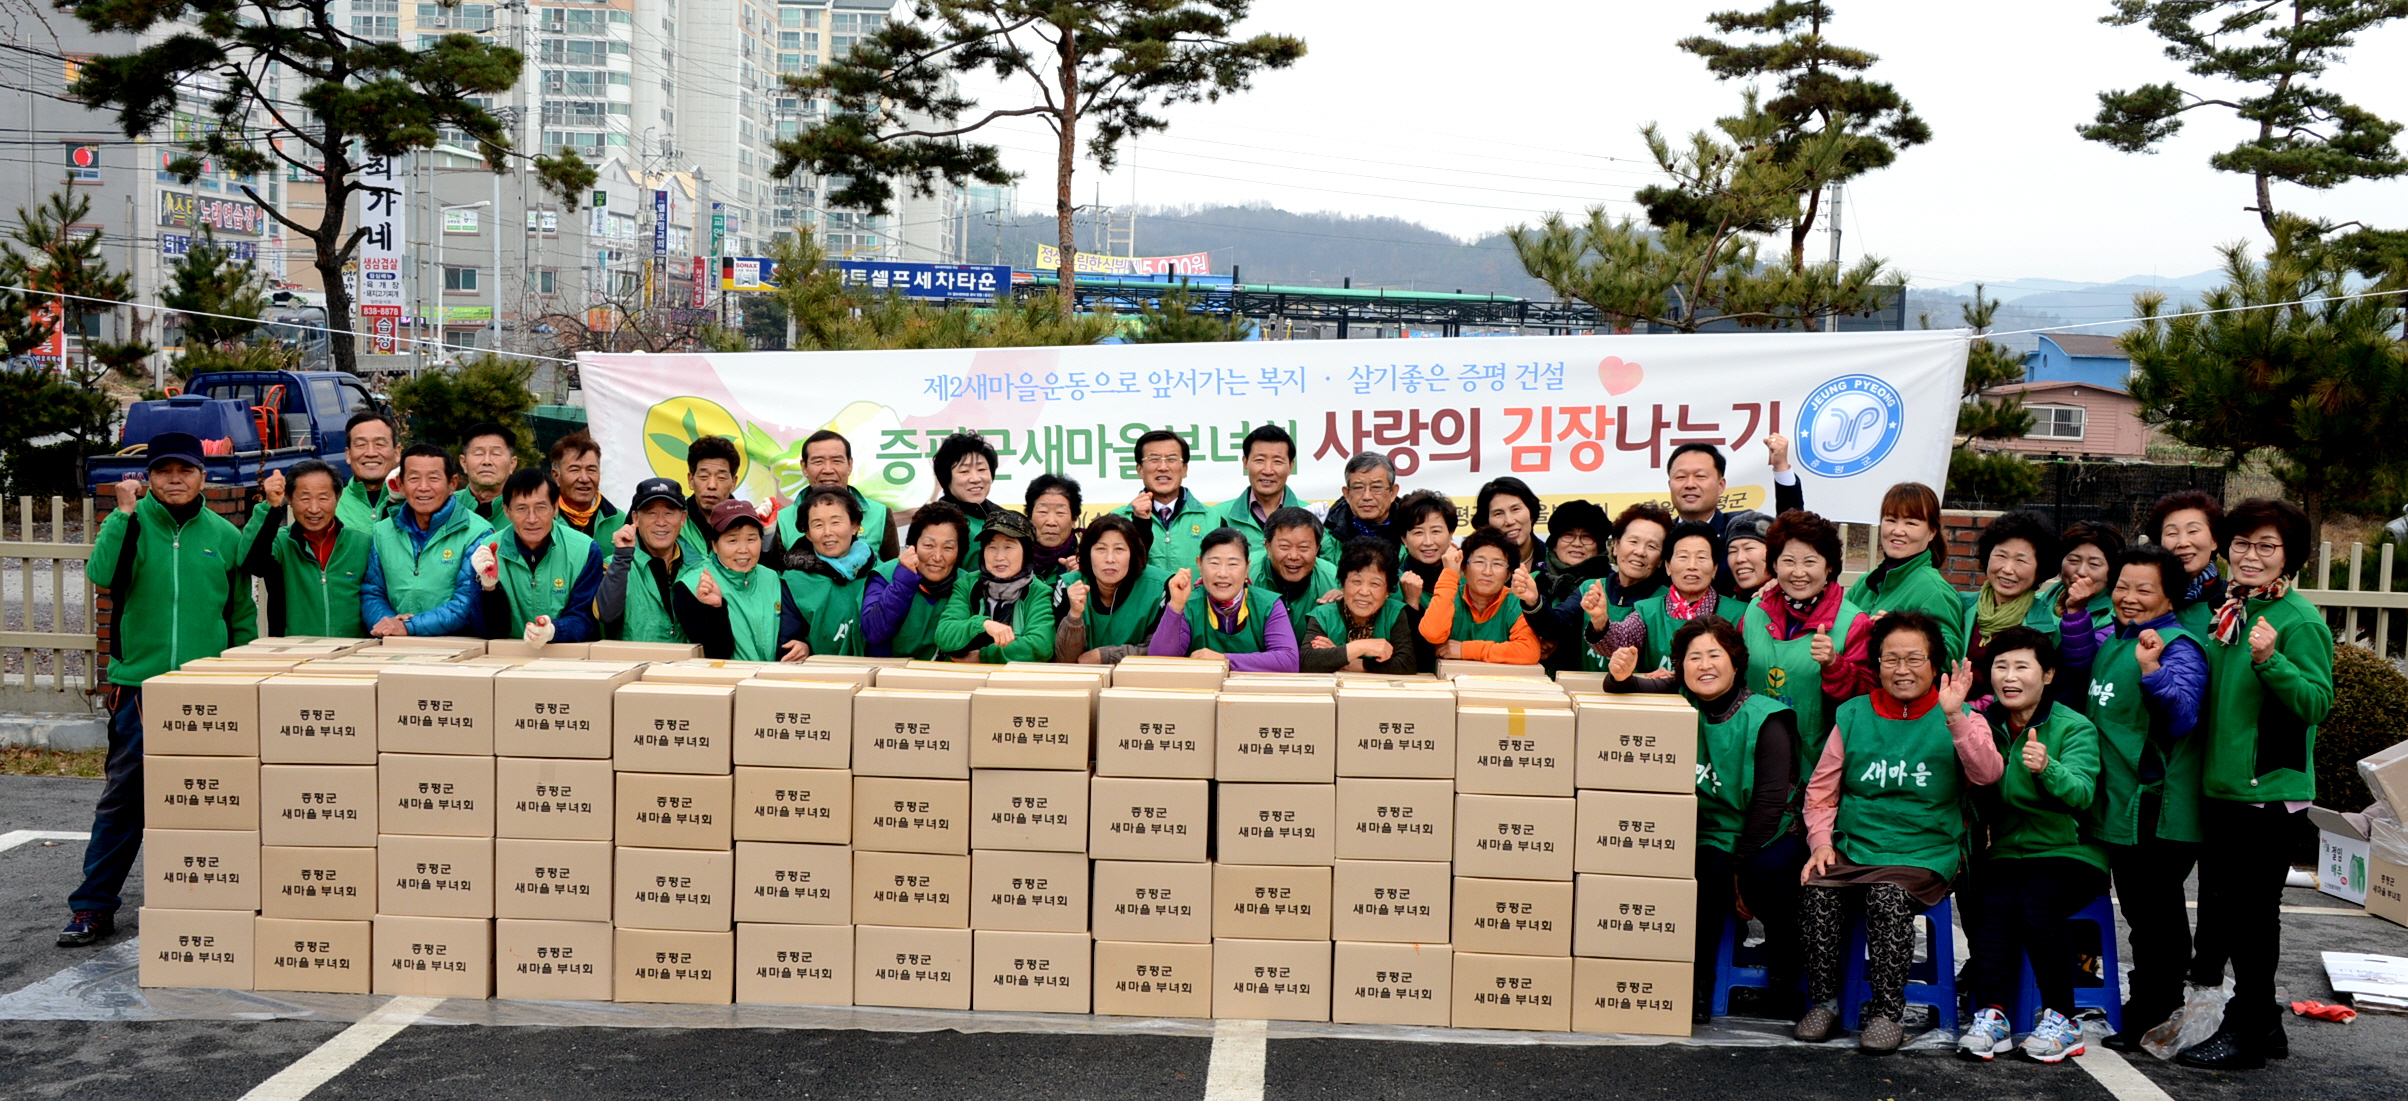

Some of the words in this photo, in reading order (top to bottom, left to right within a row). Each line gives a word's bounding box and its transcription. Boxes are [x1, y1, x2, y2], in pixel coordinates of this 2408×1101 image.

[200, 199, 255, 231] 노래연습장
[363, 257, 399, 270] 생삼겹살
[1142, 253, 1207, 275] 5000원
[363, 307, 399, 316] 838-8878
[923, 371, 1141, 402] 제2새마을운동으로
[1147, 367, 1251, 399] 앞서가는
[1256, 366, 1306, 396] 복지
[1347, 363, 1450, 395] 살기좋은
[1457, 362, 1507, 392] 증평
[1515, 361, 1566, 391] 건설
[1810, 381, 1848, 412] JEUNG
[1853, 379, 1897, 409] PYEONG
[1312, 407, 1481, 477] 사랑의
[1810, 455, 1873, 475] 증평군
[122, 471, 146, 482] KIA
[417, 699, 454, 712] 증평군
[299, 709, 336, 722] 증평군
[397, 714, 433, 727] 새마을
[437, 716, 473, 729] 부녀회
[774, 712, 811, 725] 증평군
[1012, 716, 1049, 729] 증평군
[279, 724, 316, 737] 새마을
[320, 725, 356, 737] 부녀회
[653, 718, 690, 731] 증평군
[1139, 722, 1176, 735] 증평군
[1378, 722, 1415, 735] 증평군
[633, 734, 669, 747] 새마을
[673, 735, 710, 748] 부녀회
[754, 727, 790, 740] 새마을
[794, 729, 831, 742] 부녀회
[991, 732, 1028, 745] 새마을
[1032, 733, 1069, 745] 부녀회
[1118, 738, 1155, 751] 새마을
[1159, 739, 1196, 752] 부녀회
[1357, 738, 1394, 751] 새마을
[1398, 739, 1435, 751] 부녀회
[1498, 739, 1535, 752] 증평군
[1476, 755, 1514, 768] 새마을
[1518, 756, 1555, 769] 부녀회
[1860, 759, 1933, 789] 새마을
[183, 778, 220, 791] 증평군
[418, 782, 454, 795] 증평군
[535, 785, 572, 798] 증평군
[163, 794, 200, 806] 새마을
[203, 794, 240, 807] 부녀회
[774, 789, 811, 802] 증평군
[398, 797, 434, 810] 새마을
[438, 799, 474, 811] 부녀회
[515, 800, 551, 813] 새마을
[555, 801, 592, 814] 부녀회
[893, 800, 930, 813] 증평군
[754, 805, 790, 818] 새마을
[794, 806, 831, 819] 부녀회
[1130, 806, 1168, 819] 증평군
[1258, 810, 1296, 823] 증평군
[873, 816, 909, 829] 새마을
[913, 817, 949, 830] 부녀회
[1109, 822, 1146, 835] 새마을
[1150, 823, 1187, 836] 부녀회
[1497, 822, 1535, 836] 증평군
[1618, 819, 1656, 833] 증평군
[1238, 826, 1275, 838] 새마을
[1279, 827, 1315, 839] 부녀회
[1476, 838, 1513, 852] 새마을
[1517, 840, 1555, 853] 부녀회
[1596, 835, 1634, 849] 새마을
[1638, 837, 1676, 851] 부녀회
[183, 856, 220, 868] 증평군
[163, 871, 199, 884] 새마을
[203, 872, 240, 884] 부녀회
[300, 869, 337, 882] 증평군
[534, 866, 571, 879] 증평군
[655, 875, 692, 889] 증평군
[894, 874, 930, 888] 증평군
[1011, 877, 1048, 891] 증평군
[2381, 874, 2395, 887] 증평군
[281, 884, 317, 897] 새마을
[321, 885, 357, 898] 부녀회
[514, 882, 550, 895] 새마을
[554, 883, 590, 896] 부녀회
[1254, 886, 1291, 899] 증평군
[1373, 887, 1411, 900] 증평군
[634, 891, 671, 904] 새마을
[675, 893, 711, 905] 부녀회
[873, 890, 910, 903] 새마을
[913, 892, 950, 905] 부녀회
[991, 893, 1027, 906] 새마을
[1031, 894, 1068, 907] 부녀회
[1233, 902, 1270, 915] 새마을
[1274, 903, 1311, 916] 부녀회
[1352, 903, 1389, 916] 새마을
[1393, 904, 1430, 917] 부녀회
[1618, 903, 1656, 917] 증평군
[1596, 918, 1634, 932] 새마을
[1638, 920, 1676, 934] 부녀회
[294, 940, 330, 953] 증평군
[411, 943, 447, 956] 증평군
[273, 956, 310, 969] 새마을
[314, 957, 350, 970] 부녀회
[655, 951, 692, 965] 증평군
[776, 950, 813, 964] 증평군
[391, 958, 427, 971] 새마을
[431, 960, 467, 973] 부녀회
[1013, 958, 1050, 971] 증평군
[1136, 964, 1173, 978] 증평군
[634, 967, 671, 980] 새마을
[675, 968, 712, 981] 부녀회
[756, 966, 792, 979] 새마을
[796, 967, 832, 980] 부녀회
[1375, 971, 1413, 984] 증평군
[992, 974, 1029, 987] 새마을
[1033, 975, 1070, 988] 부녀회
[1115, 980, 1152, 993] 새마을
[1156, 981, 1192, 994] 부녀회
[1495, 976, 1533, 990] 증평군
[1354, 986, 1391, 999] 새마을
[1395, 988, 1432, 1001] 부녀회
[1474, 992, 1511, 1005] 새마을
[1515, 994, 1552, 1007] 부녀회
